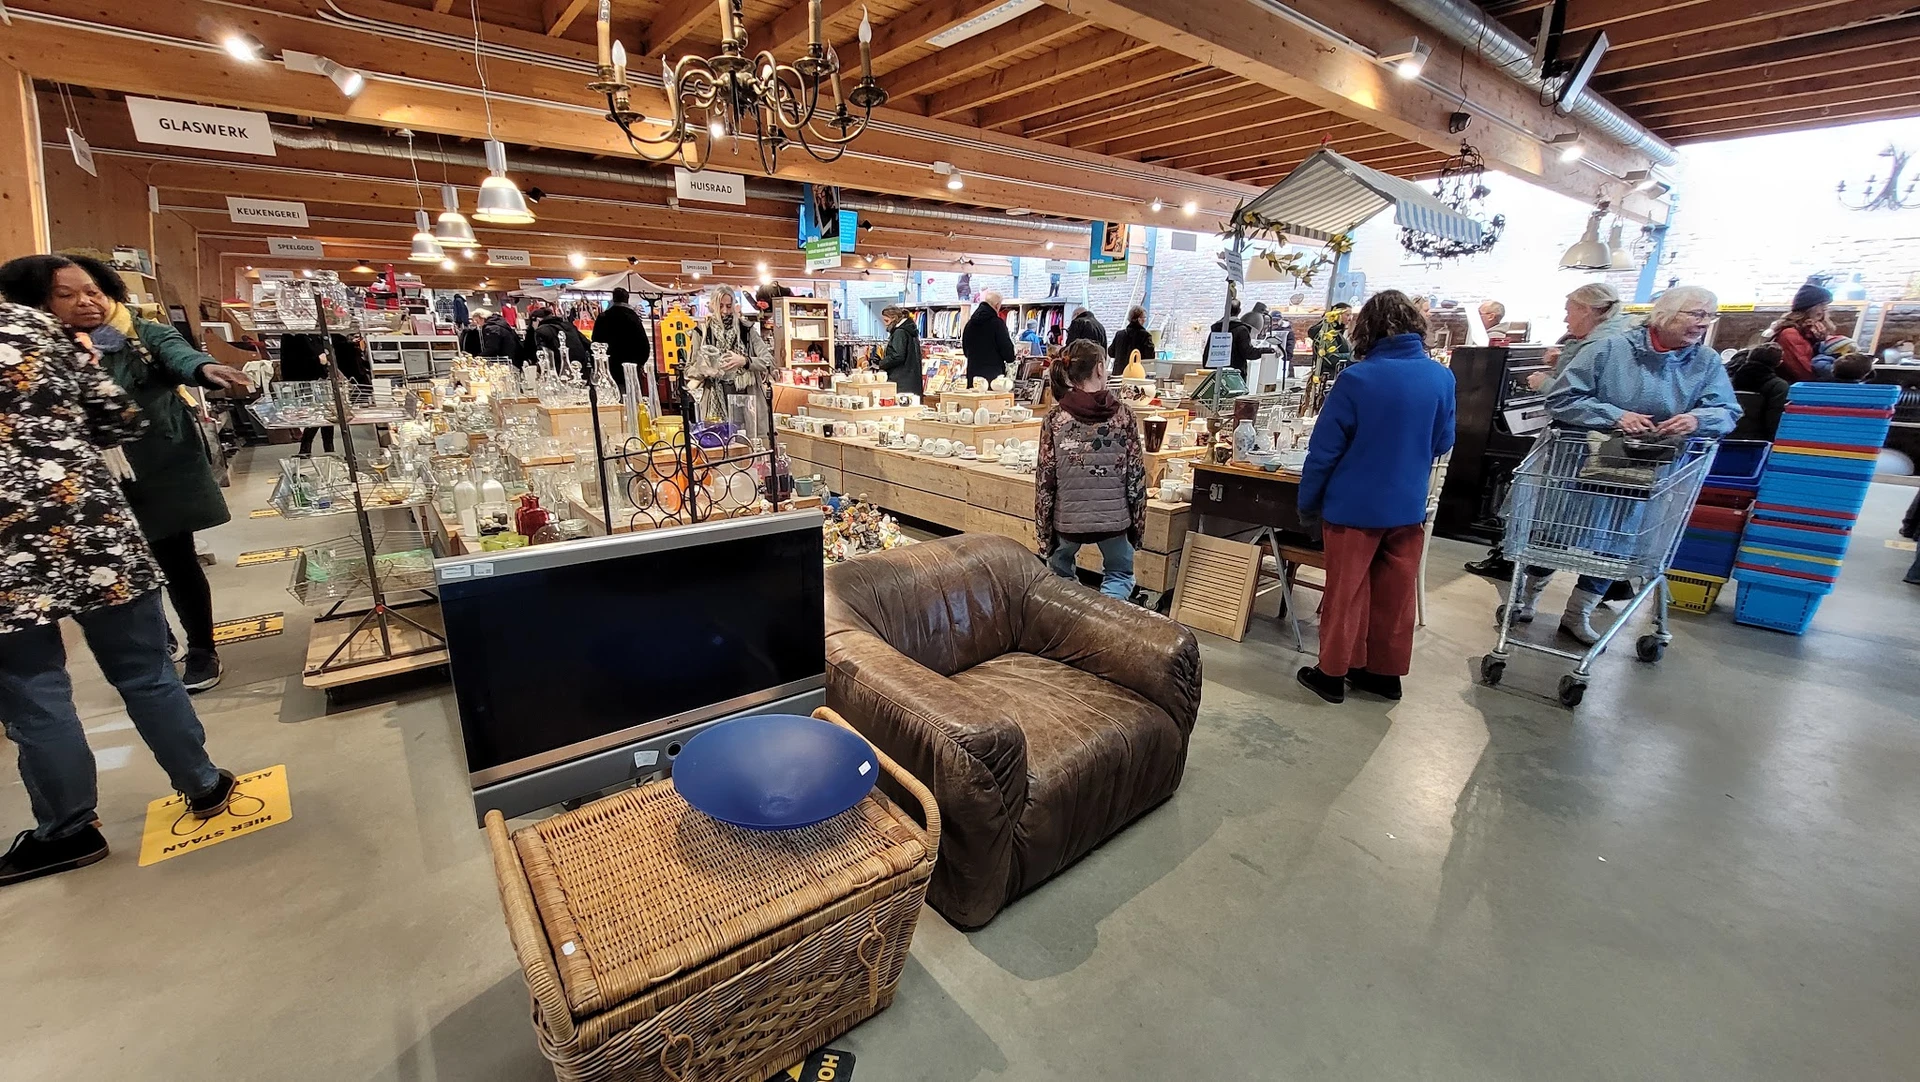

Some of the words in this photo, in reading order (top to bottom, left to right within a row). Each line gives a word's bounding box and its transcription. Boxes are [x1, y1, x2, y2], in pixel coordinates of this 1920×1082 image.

[158, 117, 249, 139] GLASWERK
[690, 181, 733, 194] HUISRAAD
[236, 207, 300, 219] KEUKENGEREI
[277, 243, 315, 251] SPEELGOED
[495, 254, 524, 262] SPEELGOED
[231, 814, 272, 833] HIER
[162, 829, 225, 854] STAAN
[817, 1053, 840, 1082] HO
